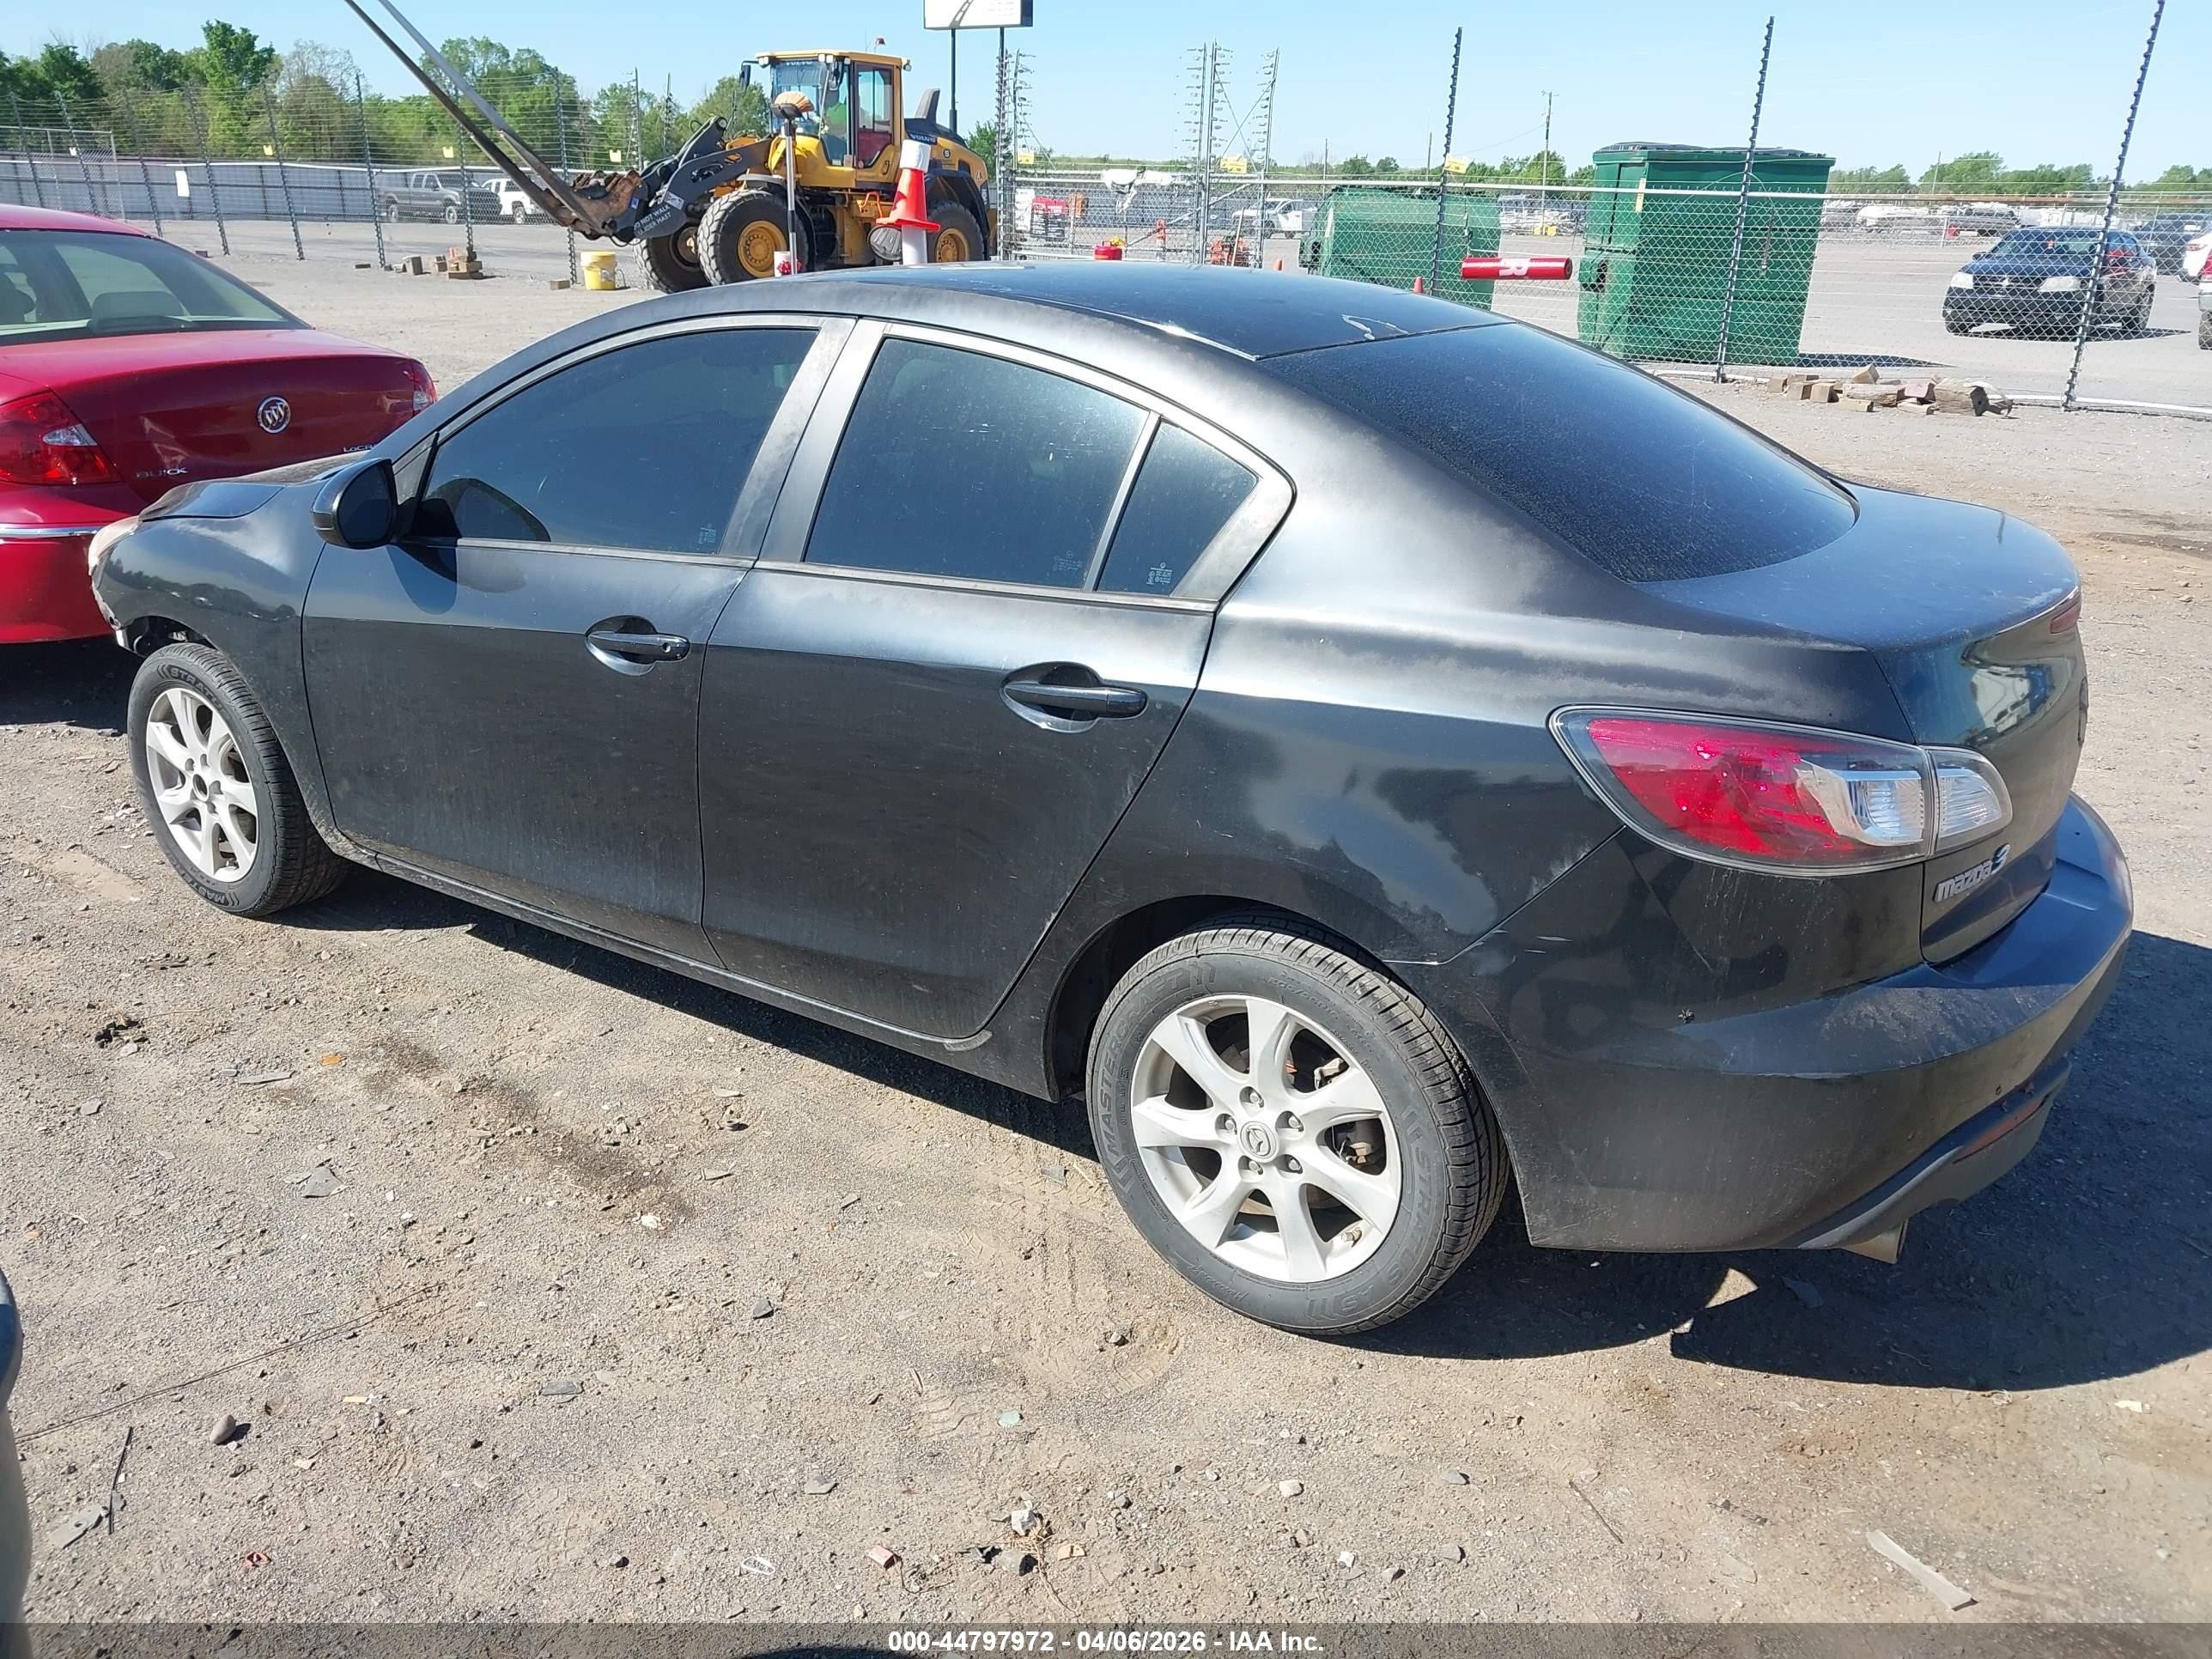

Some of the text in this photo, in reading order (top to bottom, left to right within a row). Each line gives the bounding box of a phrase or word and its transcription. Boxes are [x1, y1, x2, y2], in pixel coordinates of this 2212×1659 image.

[910, 134, 936, 143] VOLVO
[638, 212, 671, 234] UDER MAST
[640, 214, 653, 224] NOT
[653, 205, 669, 216] WALK
[136, 467, 188, 478] BUICK
[169, 667, 228, 715] STRATU
[1099, 970, 1184, 1156] MASTERCRAFT
[1385, 1145, 1432, 1286] STRATUS
